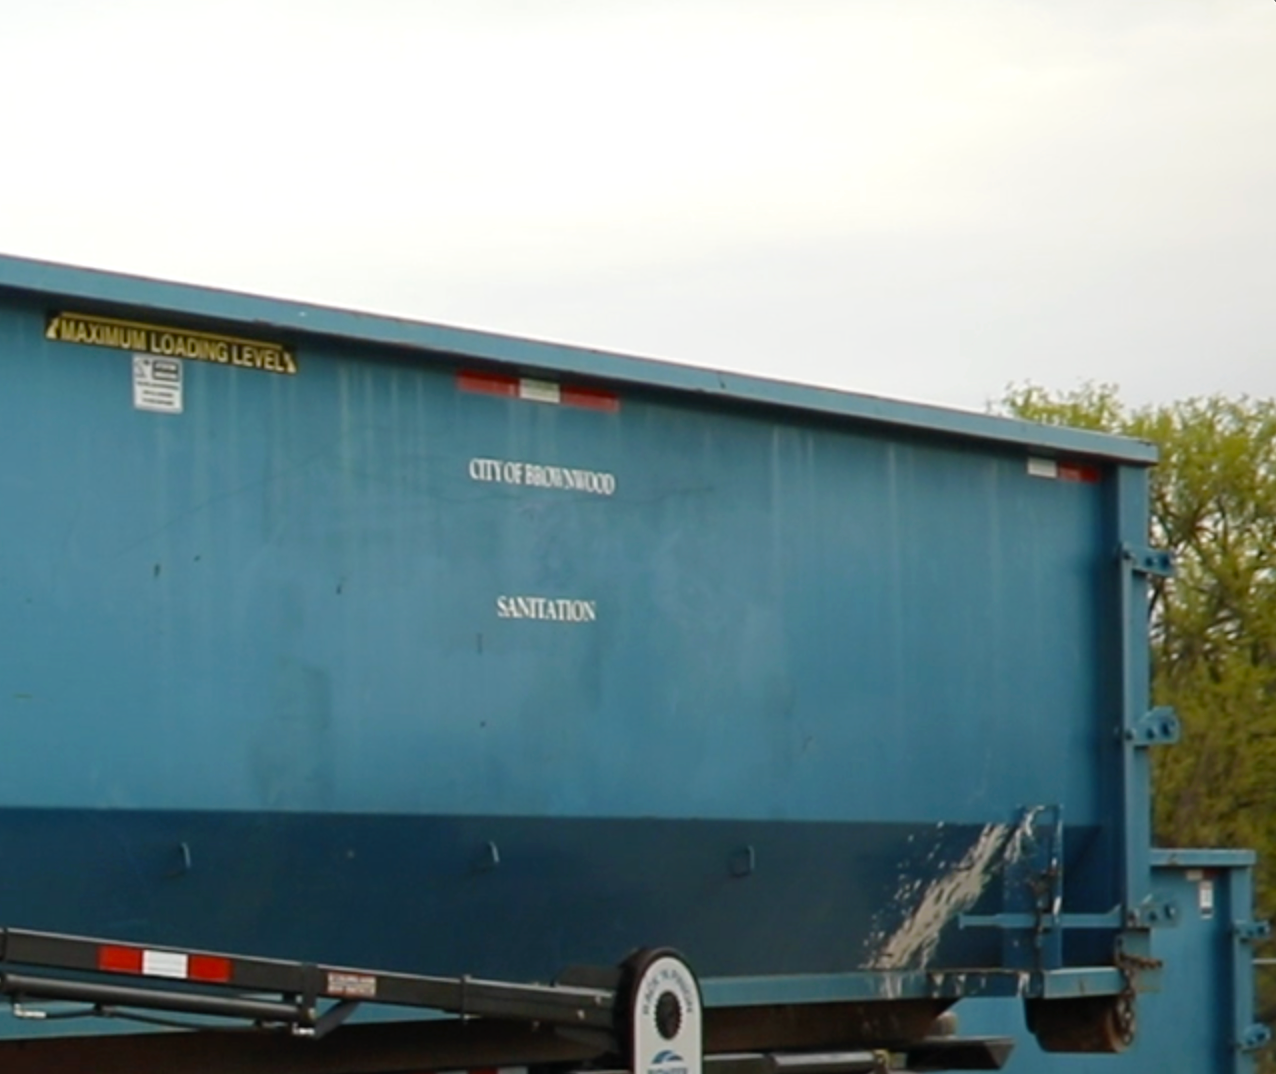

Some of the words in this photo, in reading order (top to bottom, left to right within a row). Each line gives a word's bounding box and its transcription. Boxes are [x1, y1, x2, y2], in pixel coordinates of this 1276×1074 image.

[60, 319, 147, 352] MAXIMUM
[150, 332, 228, 362] LOADING
[231, 345, 286, 372] LEVEL
[469, 458, 502, 482] CITY
[504, 461, 523, 485] OF
[525, 463, 616, 496] BROWNWOOD
[496, 594, 597, 623] SANITATION
